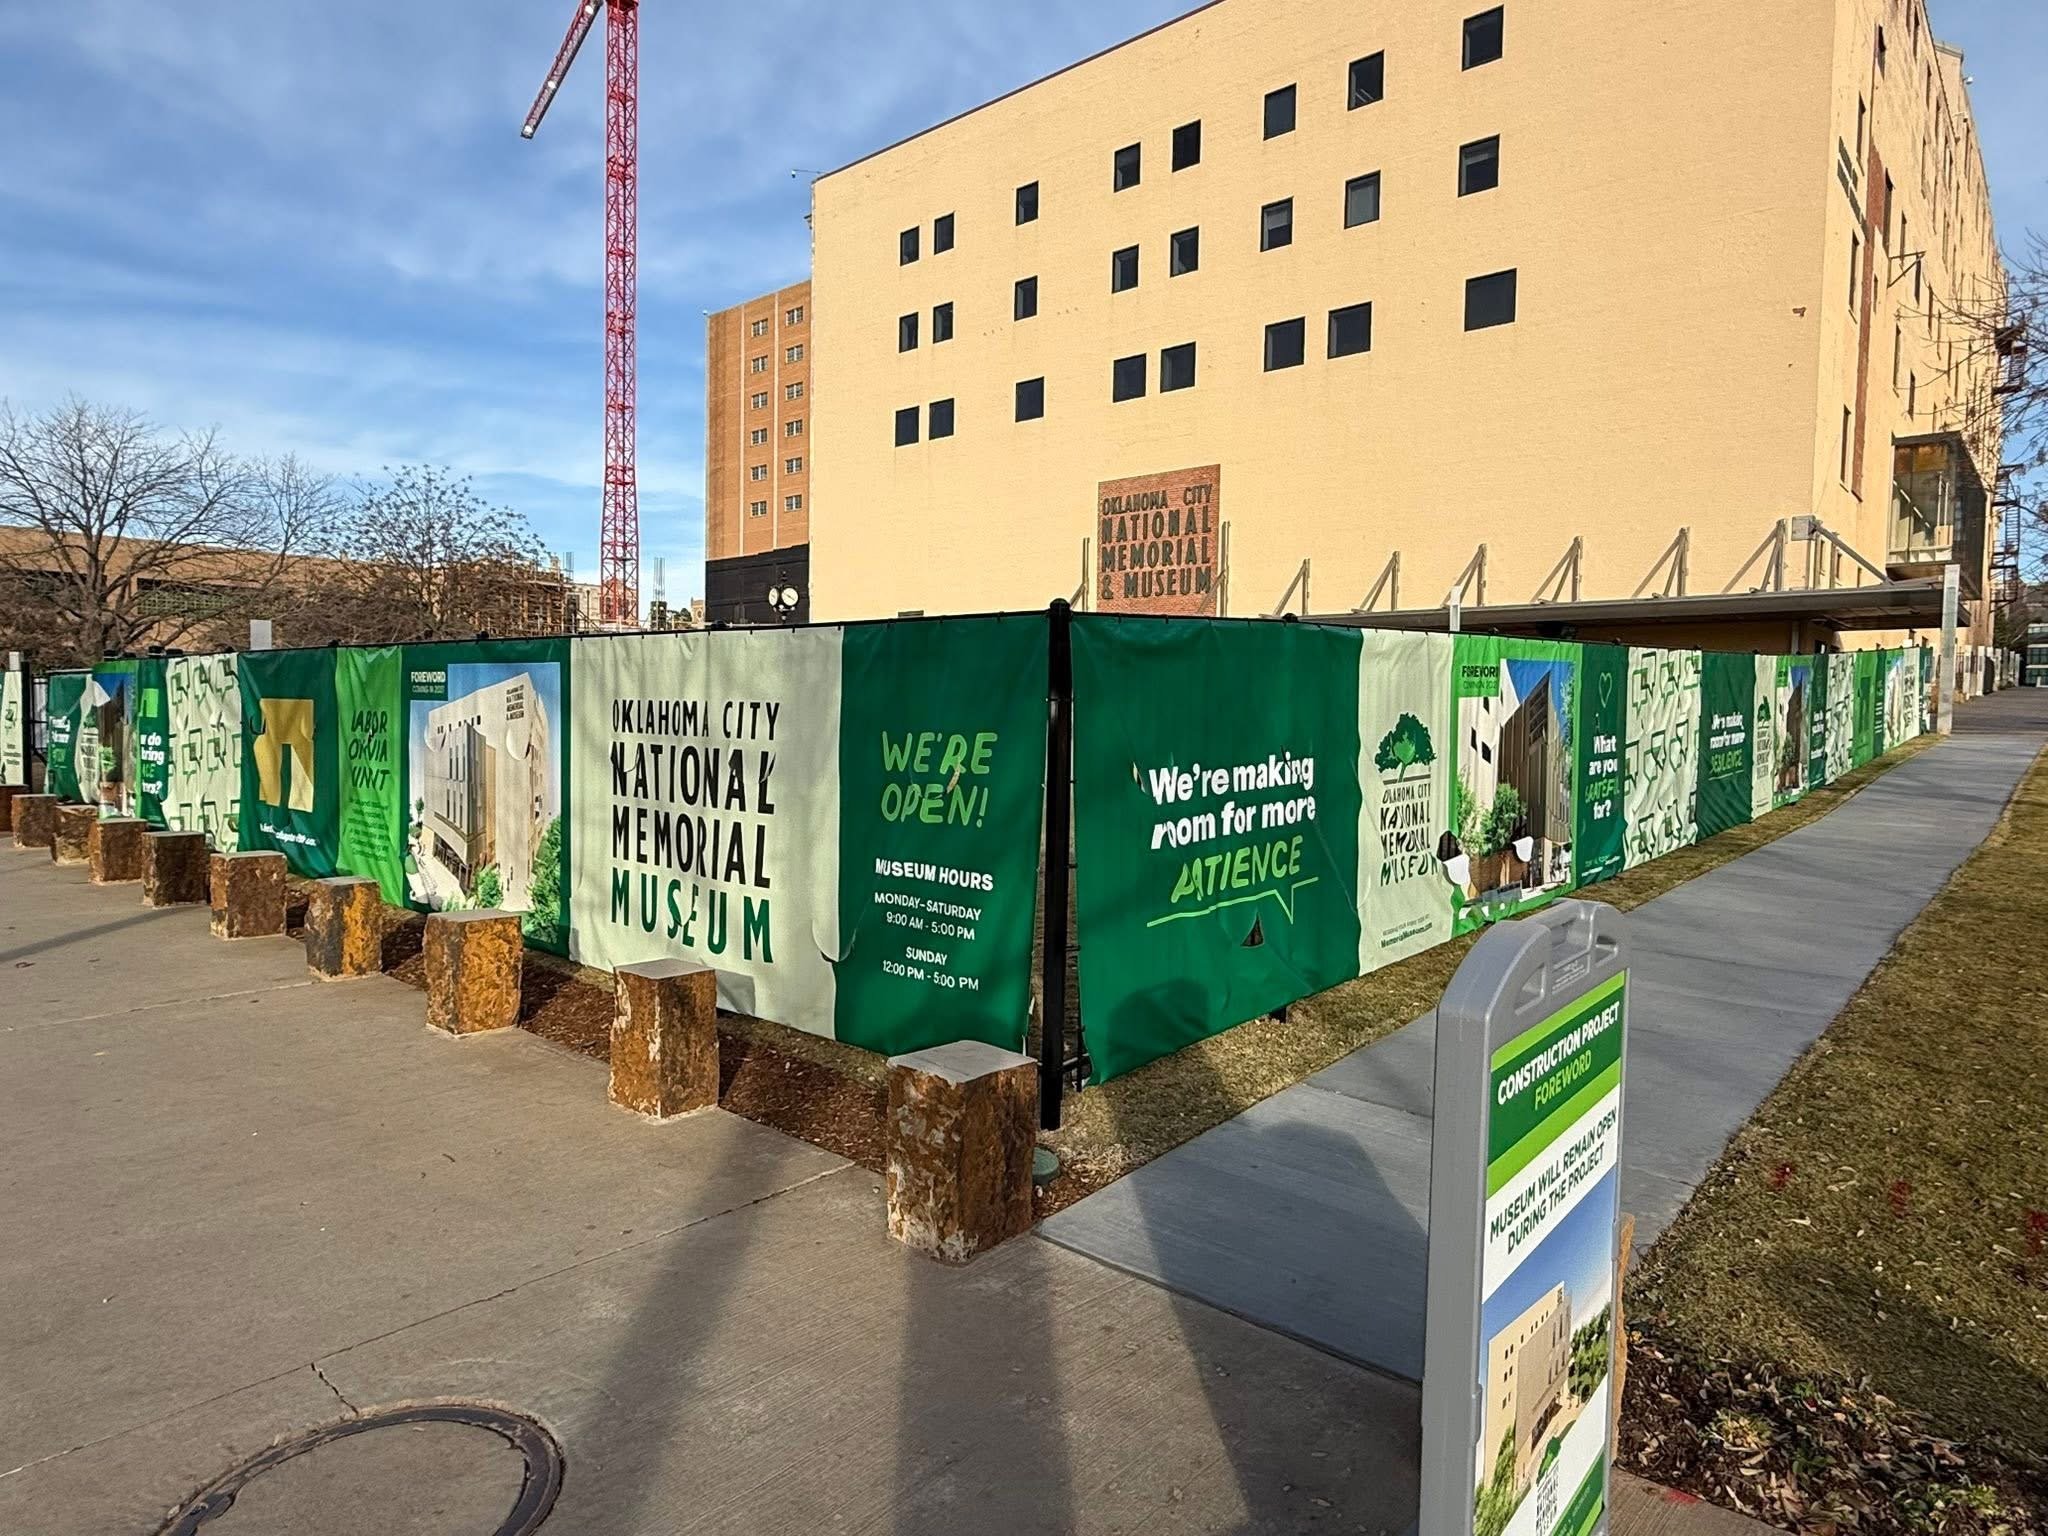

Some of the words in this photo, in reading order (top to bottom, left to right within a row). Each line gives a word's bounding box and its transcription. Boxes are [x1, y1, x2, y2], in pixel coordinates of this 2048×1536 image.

[1102, 490, 1168, 516] OKLAHOMA
[1183, 484, 1213, 505] CITY
[1101, 505, 1212, 544] NATIONAL
[1101, 536, 1210, 573] MEMORIAL
[1102, 574, 1114, 600] &
[1123, 566, 1212, 599] MUSEUM
[410, 671, 446, 683] FOREWORD
[351, 710, 388, 734] LABOR
[612, 699, 709, 737] OKLAHOMA
[722, 700, 781, 741] CITY
[882, 730, 998, 775] WE'RE
[1588, 761, 1602, 776] are
[610, 741, 777, 815] NATIONAL
[1149, 762, 1230, 805] We're
[1232, 751, 1314, 792] making
[881, 783, 988, 828] OPEN!
[1150, 811, 1217, 850] room
[1221, 801, 1257, 836] for
[1261, 796, 1316, 830] more
[1593, 799, 1612, 820] for?
[612, 804, 771, 889] MEMORIAL
[875, 857, 937, 881] MUSEUM
[938, 866, 994, 891] HOURS
[611, 866, 774, 964] MUSEUM
[886, 911, 907, 926] 9:00
[908, 916, 924, 930] AM
[931, 921, 955, 937] 5:00
[956, 926, 975, 940] PM
[882, 960, 906, 977] 12:00
[907, 966, 925, 981] PM
[933, 971, 956, 988] 5:00
[959, 976, 979, 991] PM
[905, 946, 948, 966] SUNDAY
[1497, 1026, 1581, 1105] CONSTRUCTION
[1581, 1001, 1620, 1046] PROJECT
[1535, 1049, 1592, 1110] FOREWORD
[1490, 1181, 1536, 1243] MUSEUM
[1538, 1159, 1561, 1196] WILL
[1562, 1127, 1596, 1173] REMAIN
[1596, 1107, 1617, 1139] OPEN
[1507, 1199, 1547, 1255] DURING
[1548, 1179, 1567, 1212] THE
[1567, 1142, 1605, 1193] PROJECT
